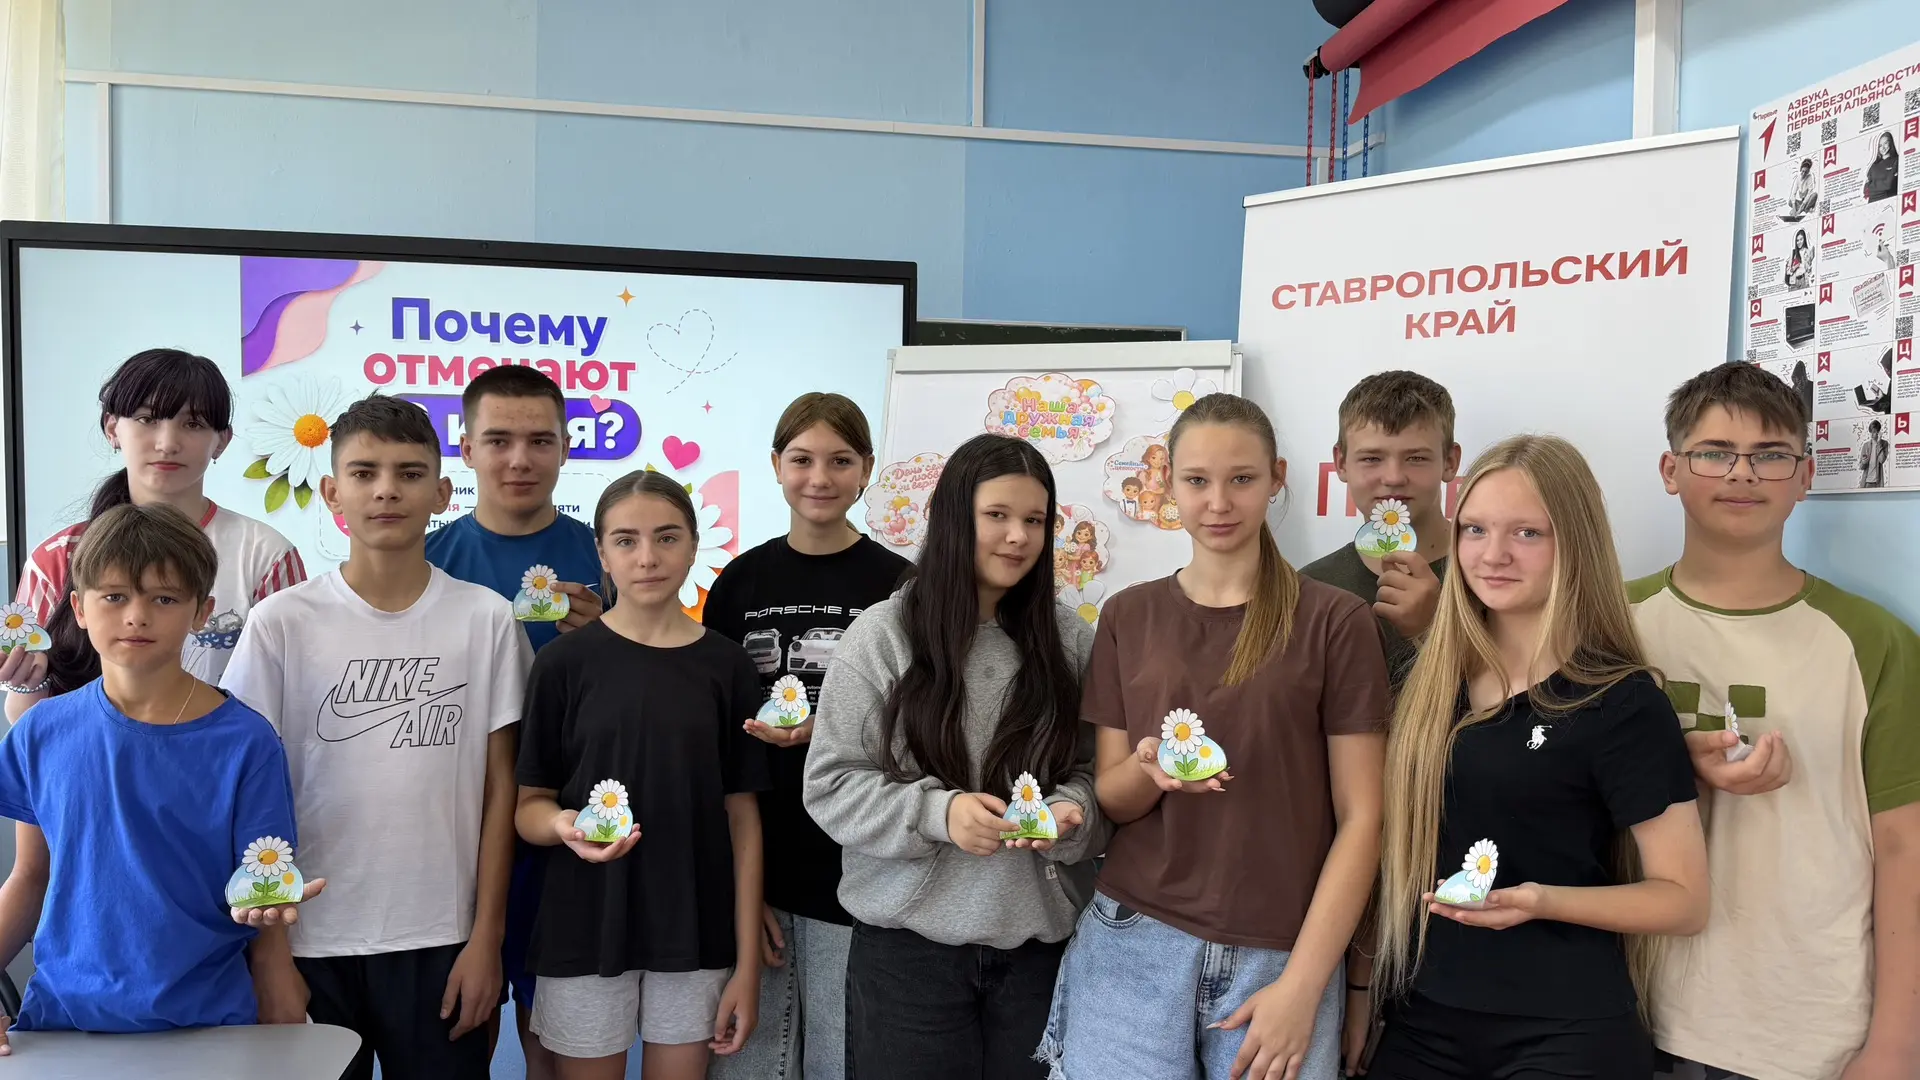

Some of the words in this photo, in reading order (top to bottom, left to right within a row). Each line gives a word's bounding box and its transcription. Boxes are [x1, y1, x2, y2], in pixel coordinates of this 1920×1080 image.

[1788, 63, 1920, 122] КИБЕРБЕЗОПАСНОСТИ
[1788, 88, 1829, 112] АЗБУКА
[1787, 107, 1831, 133] ПЕРВЫХ
[1834, 104, 1842, 115] И
[1844, 82, 1902, 112] АЛЬЯНСА
[1907, 122, 1917, 134] Е
[1824, 149, 1835, 164] Д
[1757, 173, 1764, 185] Г
[1904, 194, 1914, 208] К
[1823, 215, 1833, 230] Й
[1753, 238, 1762, 249] И
[1271, 238, 1688, 310] СТАВРОПОЛЬСКИЙ
[1902, 269, 1912, 281] Р
[1821, 286, 1831, 299] П
[1752, 302, 1760, 313] О
[391, 296, 608, 357] Почему
[1405, 299, 1517, 340] КРАЙ
[1899, 342, 1910, 356] Ц
[1820, 355, 1828, 367] Х
[363, 352, 637, 392] отмеают
[1021, 397, 1078, 414] Наша
[1002, 410, 1096, 428] дружная
[1018, 425, 1080, 440] семья
[1817, 424, 1828, 435] Ы
[892, 467, 922, 480] День
[925, 463, 946, 472] сем
[909, 470, 940, 482] любв
[744, 605, 843, 621] PORSCHE
[335, 657, 440, 704] NIKE
[390, 704, 463, 749] AIR
